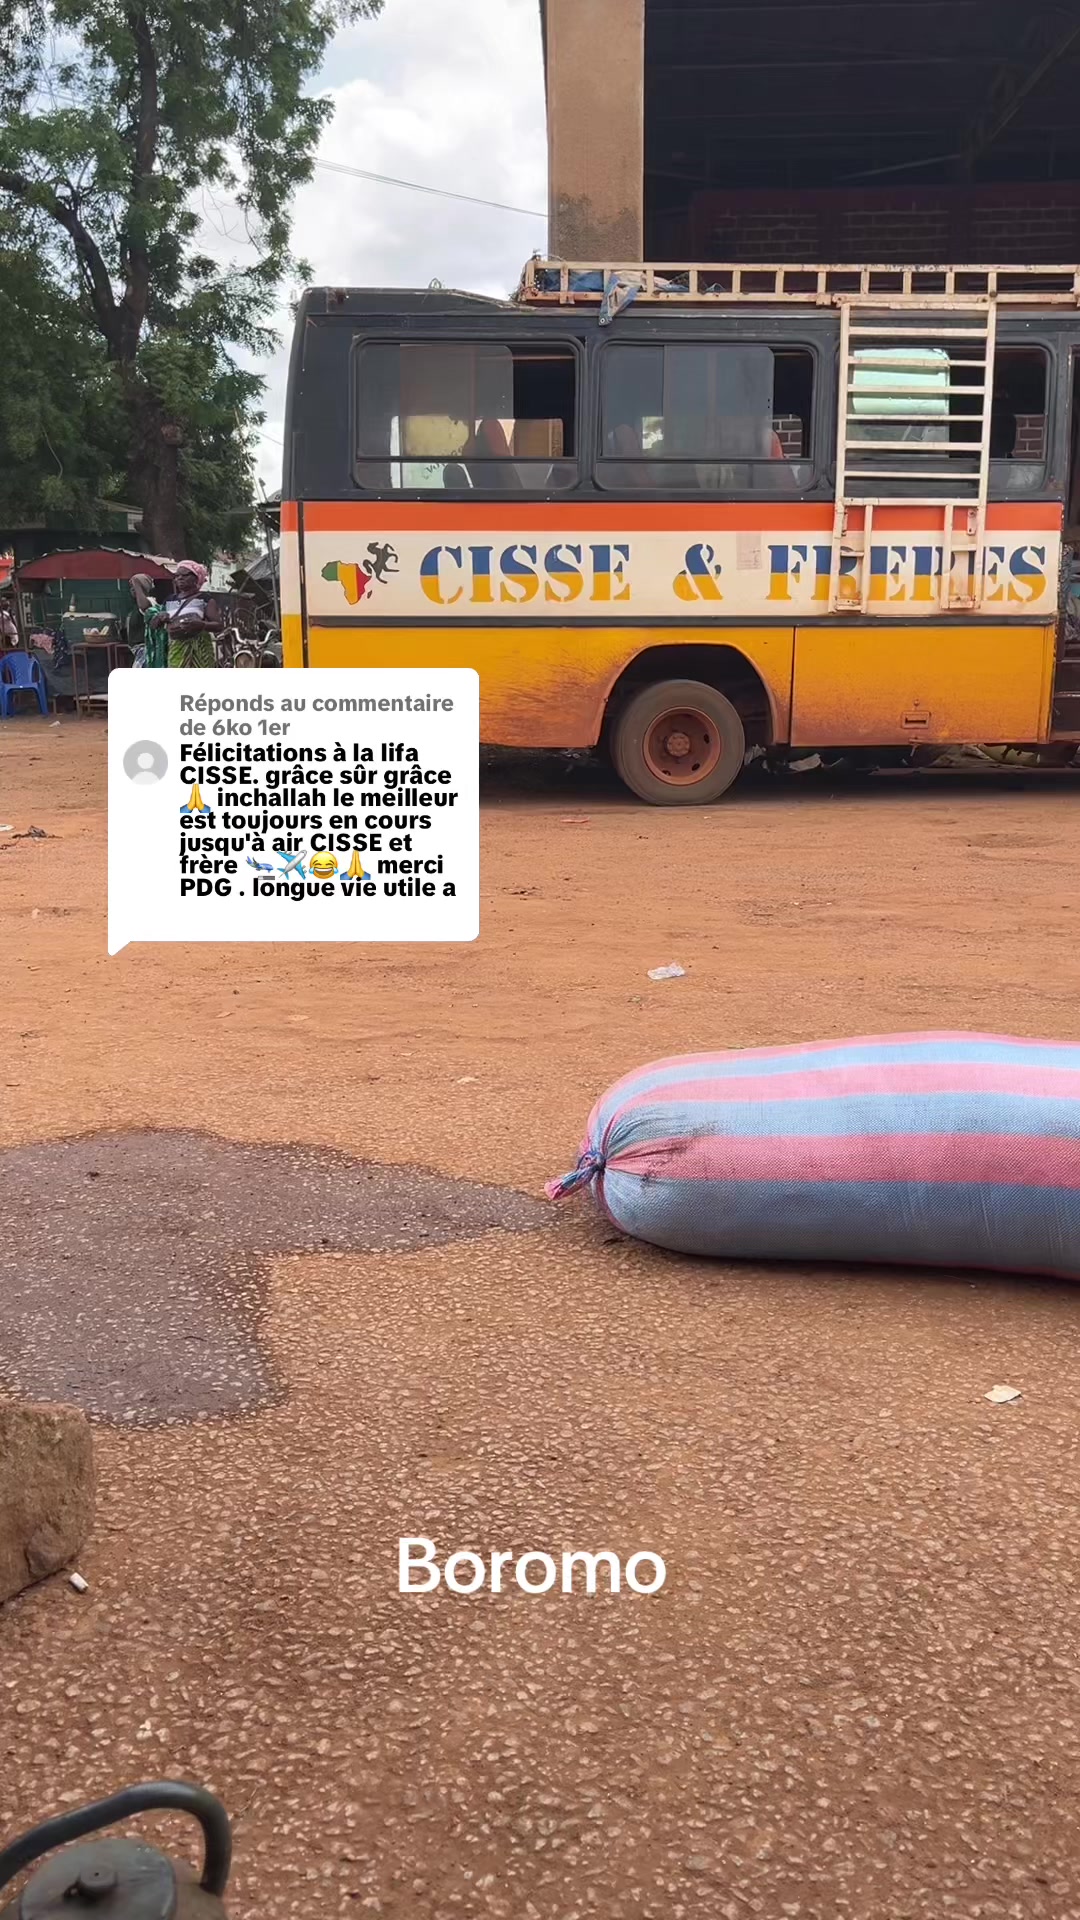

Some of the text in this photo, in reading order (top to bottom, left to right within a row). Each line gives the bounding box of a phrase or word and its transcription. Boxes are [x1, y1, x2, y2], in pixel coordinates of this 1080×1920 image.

[419, 543, 1046, 604] CISSE & FRERES
